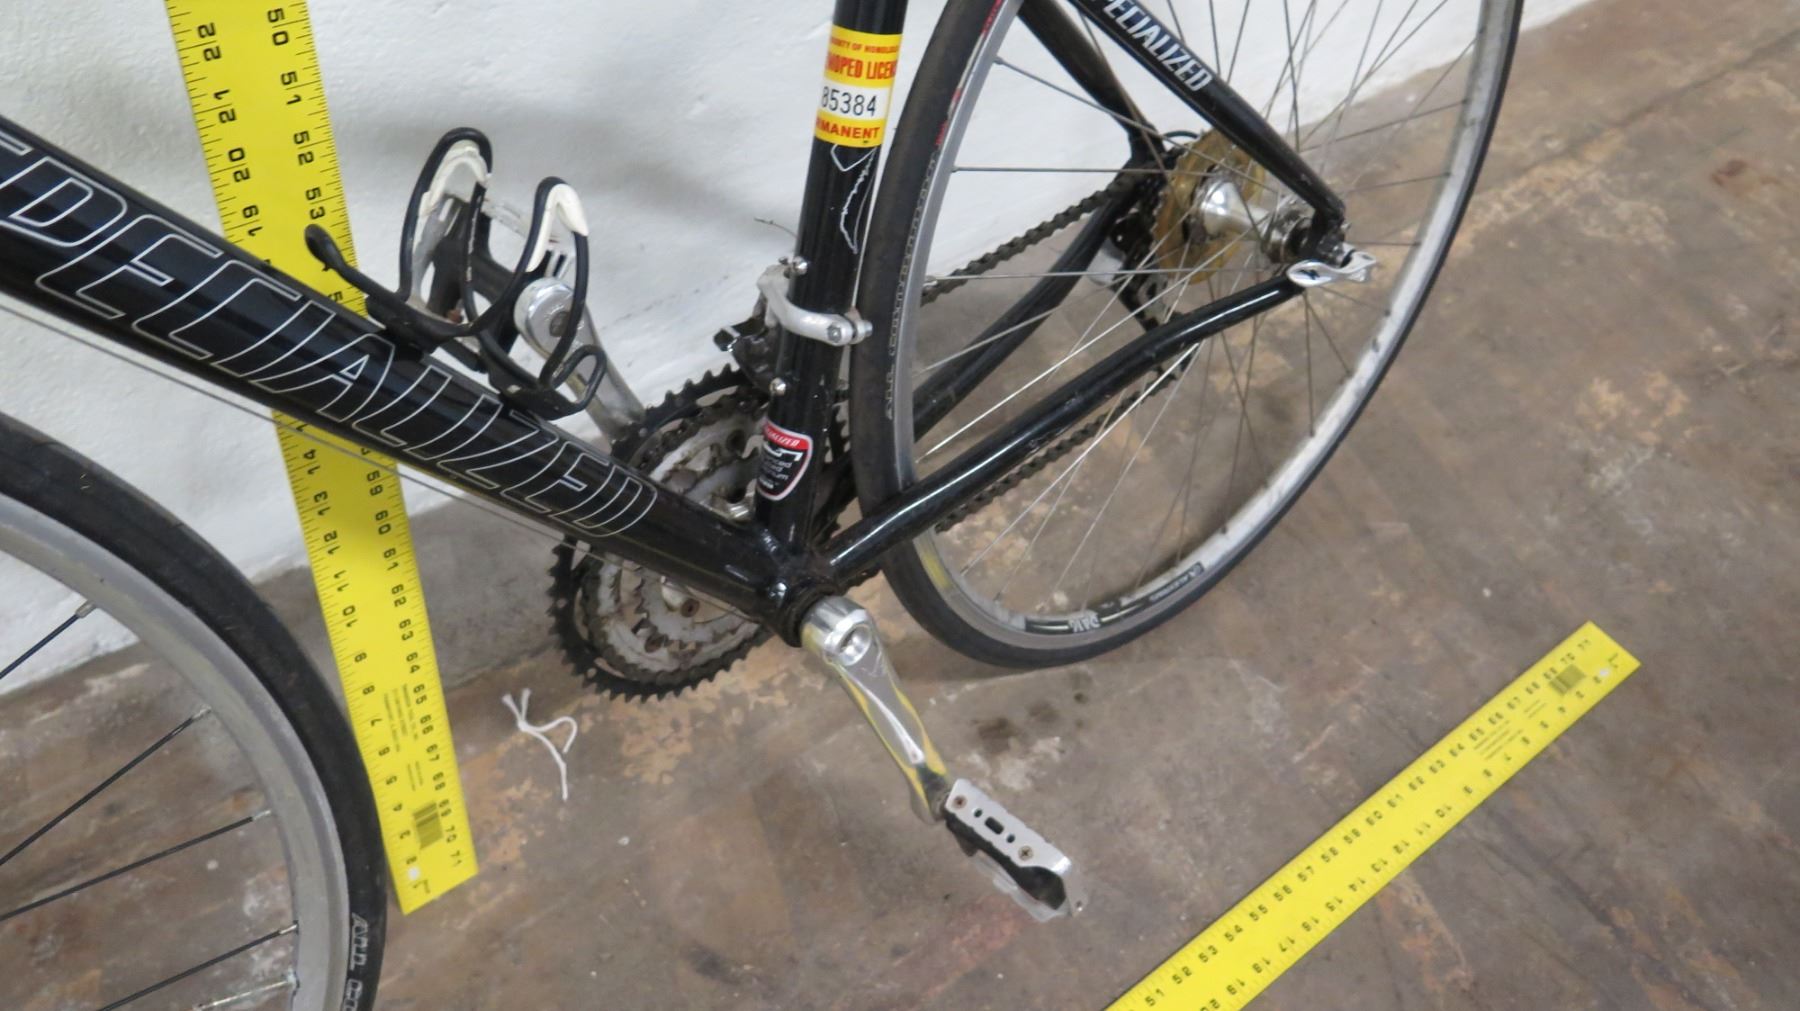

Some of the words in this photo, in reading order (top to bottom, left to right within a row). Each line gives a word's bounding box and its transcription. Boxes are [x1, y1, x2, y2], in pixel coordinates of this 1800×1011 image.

[1100, 0, 1213, 92] ECIALIZED
[267, 7, 290, 46] 50
[281, 70, 302, 105] 51
[293, 130, 314, 165] 52
[305, 187, 325, 219] 53
[197, 22, 221, 61] 22
[214, 89, 237, 123] 21
[228, 147, 250, 182] 20
[242, 204, 263, 236] 19
[367, 470, 383, 496] 59
[375, 510, 391, 535] 60
[303, 449, 320, 475] 14
[314, 491, 331, 516] 13
[324, 530, 340, 555] 12
[334, 570, 349, 592] 11
[342, 605, 358, 628] 10
[383, 548, 399, 571] 61
[391, 584, 407, 607] 62
[399, 618, 414, 641] 63
[406, 652, 420, 674] 64
